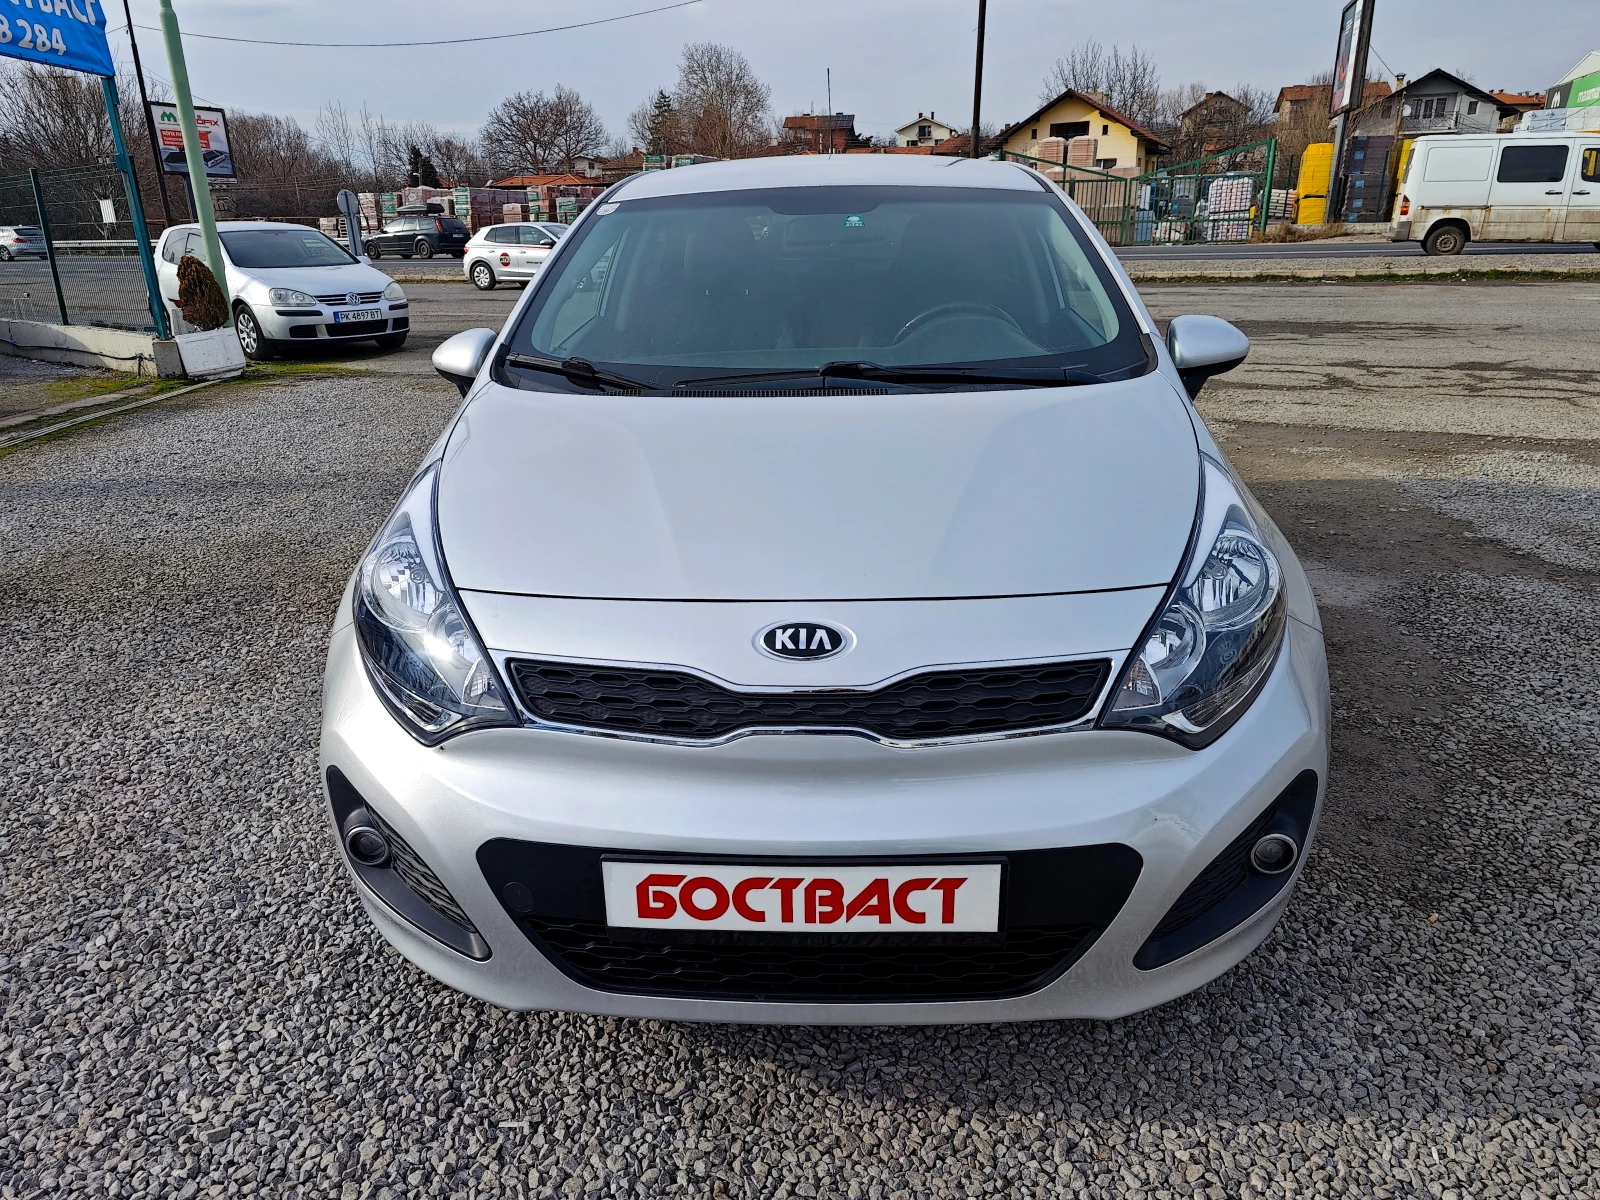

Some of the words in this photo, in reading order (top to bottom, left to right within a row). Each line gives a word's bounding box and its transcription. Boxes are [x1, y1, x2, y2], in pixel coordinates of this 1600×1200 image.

[16, 19, 67, 56] 284
[351, 311, 369, 321] 4897
[775, 627, 832, 650] KIA
[635, 873, 969, 924] БОСТВАСТ
